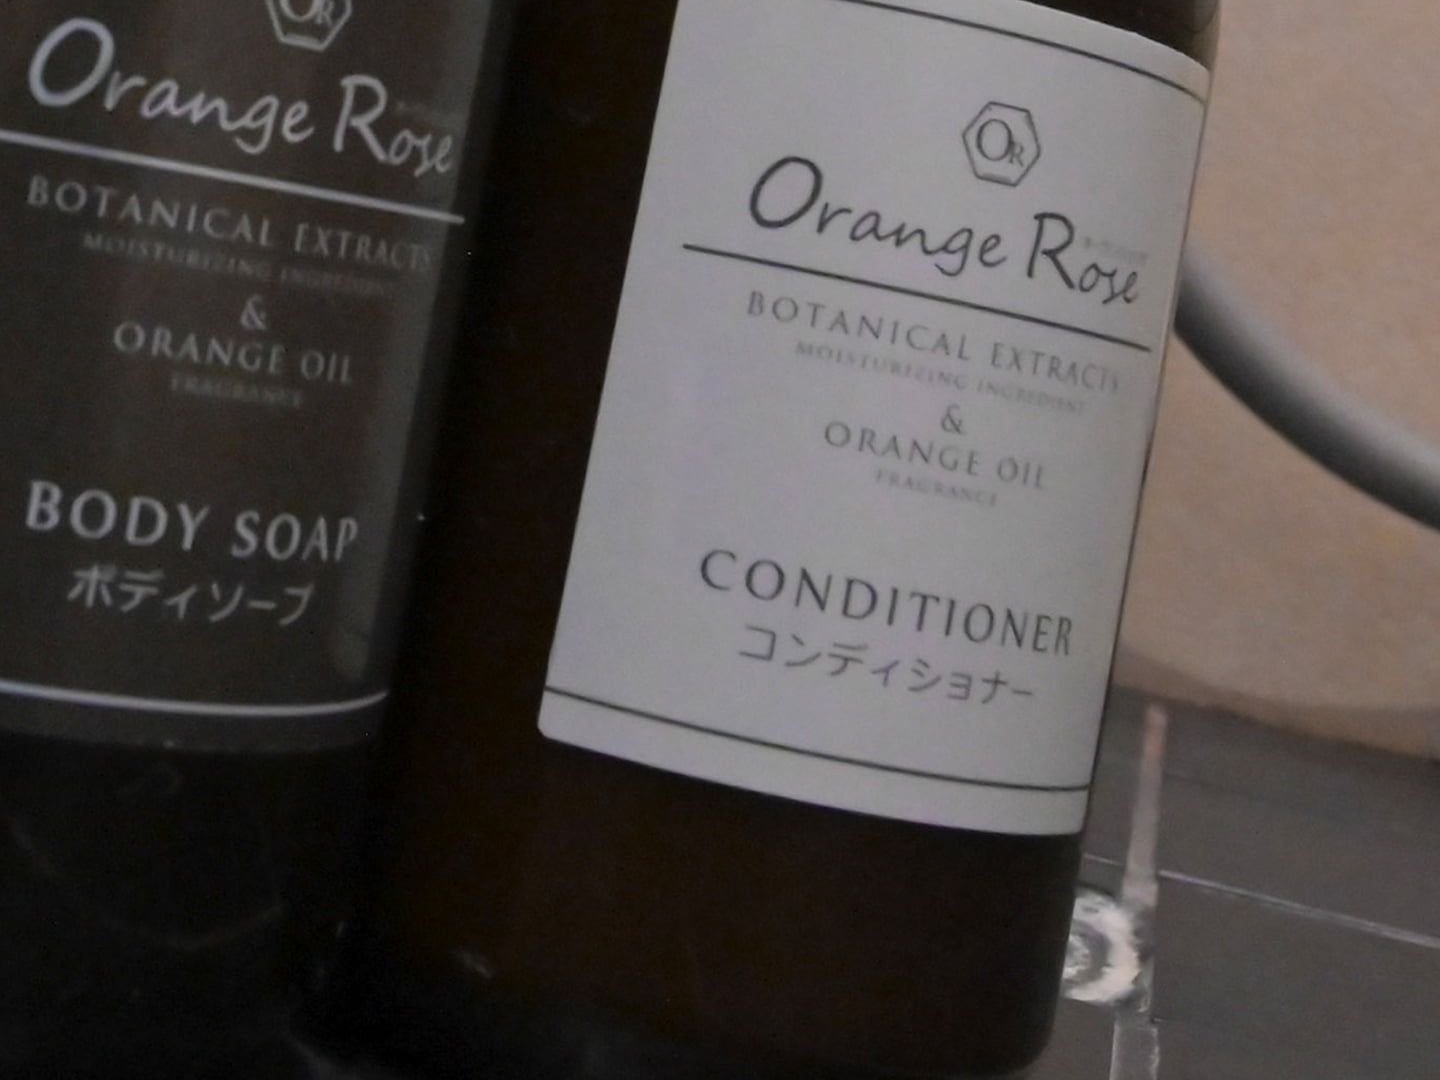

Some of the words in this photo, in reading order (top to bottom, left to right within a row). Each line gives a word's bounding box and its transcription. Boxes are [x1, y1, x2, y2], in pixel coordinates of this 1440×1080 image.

[27, 16, 317, 156] Orange
[332, 72, 455, 179] Rose
[25, 172, 274, 249] BOTANICAL
[748, 154, 1010, 278] Orange
[1026, 211, 1141, 307] Rose
[238, 291, 270, 333] &
[746, 288, 972, 363] BOTANICAL
[111, 320, 287, 378] ORANGE
[298, 348, 354, 387] OIL
[822, 418, 981, 477] ORANGE
[995, 455, 1047, 491] OIL
[939, 402, 968, 437] &
[23, 477, 211, 554] BODY
[228, 506, 361, 564] SOAP
[698, 546, 1074, 658] CONDITIONER
[737, 622, 1036, 706] コンディショナー
